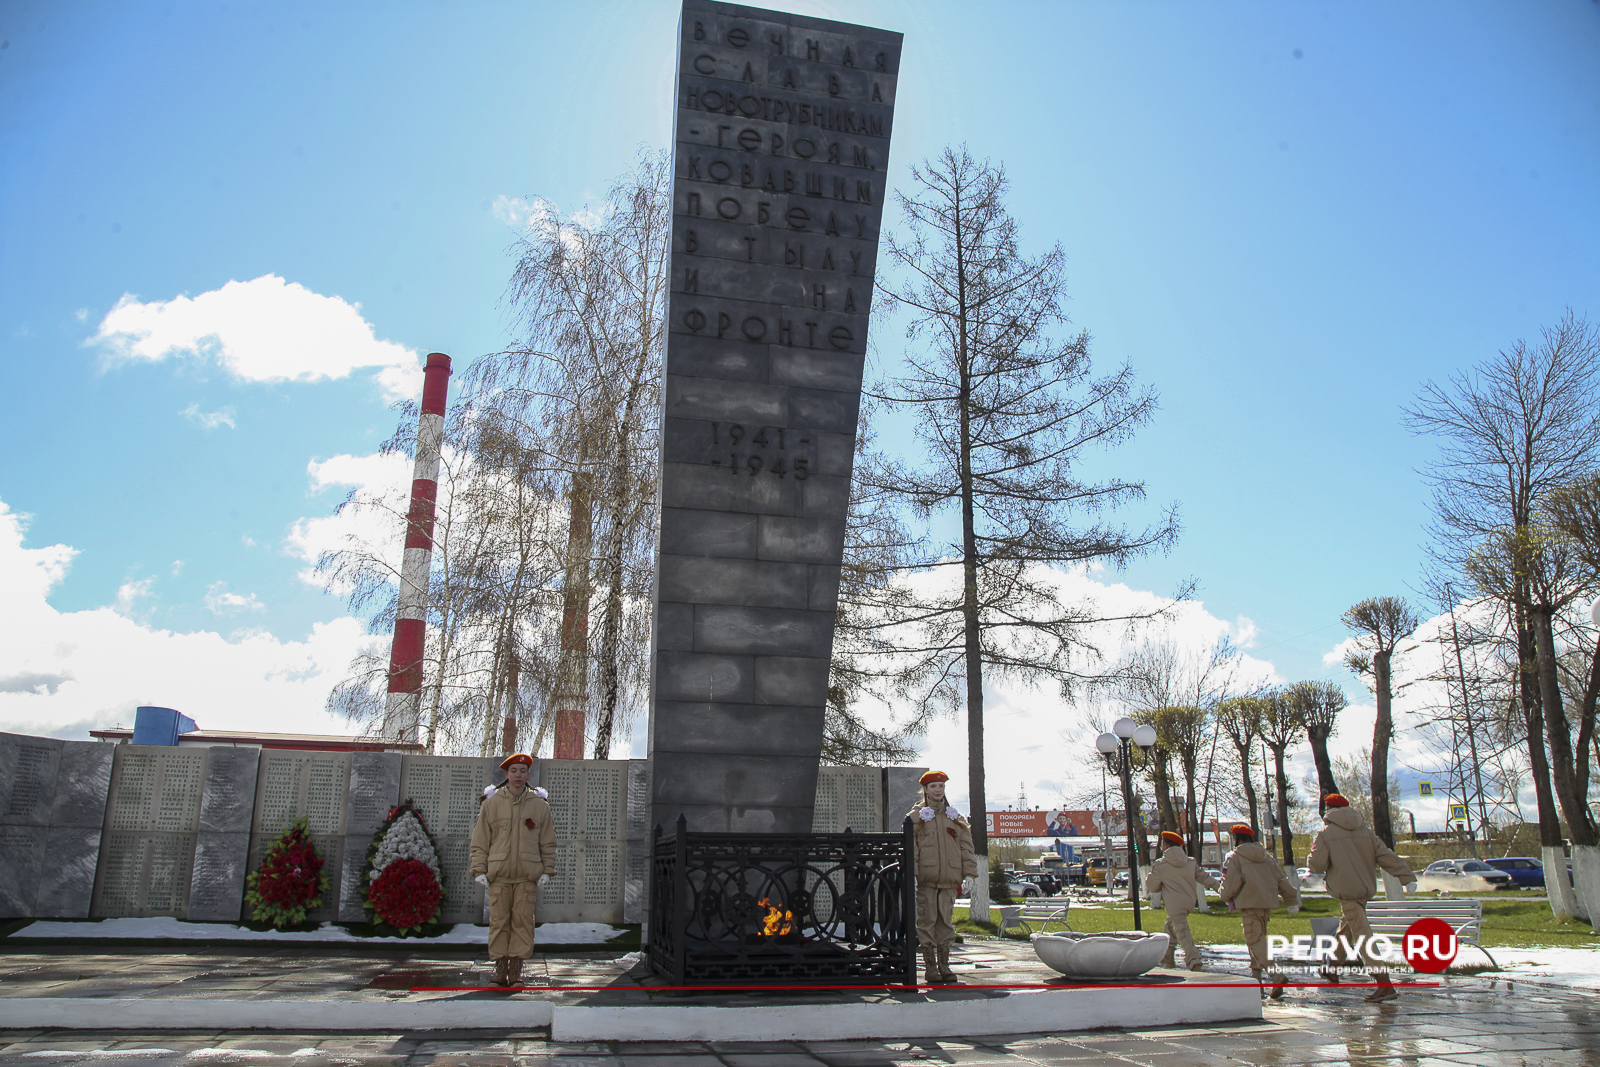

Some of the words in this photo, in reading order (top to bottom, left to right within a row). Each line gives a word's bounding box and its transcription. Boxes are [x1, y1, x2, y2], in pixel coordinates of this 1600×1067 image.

[693, 20, 886, 72] ВЕЧНАЯ
[693, 54, 883, 103] СЛАВА
[686, 85, 884, 136] НОВОТРУБНИКАМ
[688, 156, 871, 203] КОВАВШИМ
[687, 192, 867, 237] ПОБЕДУ
[686, 229, 699, 253] В
[744, 237, 862, 274] ТЫЛУ
[684, 267, 699, 293] И
[813, 283, 857, 313] НА
[683, 308, 854, 349] ФРОНТЕ
